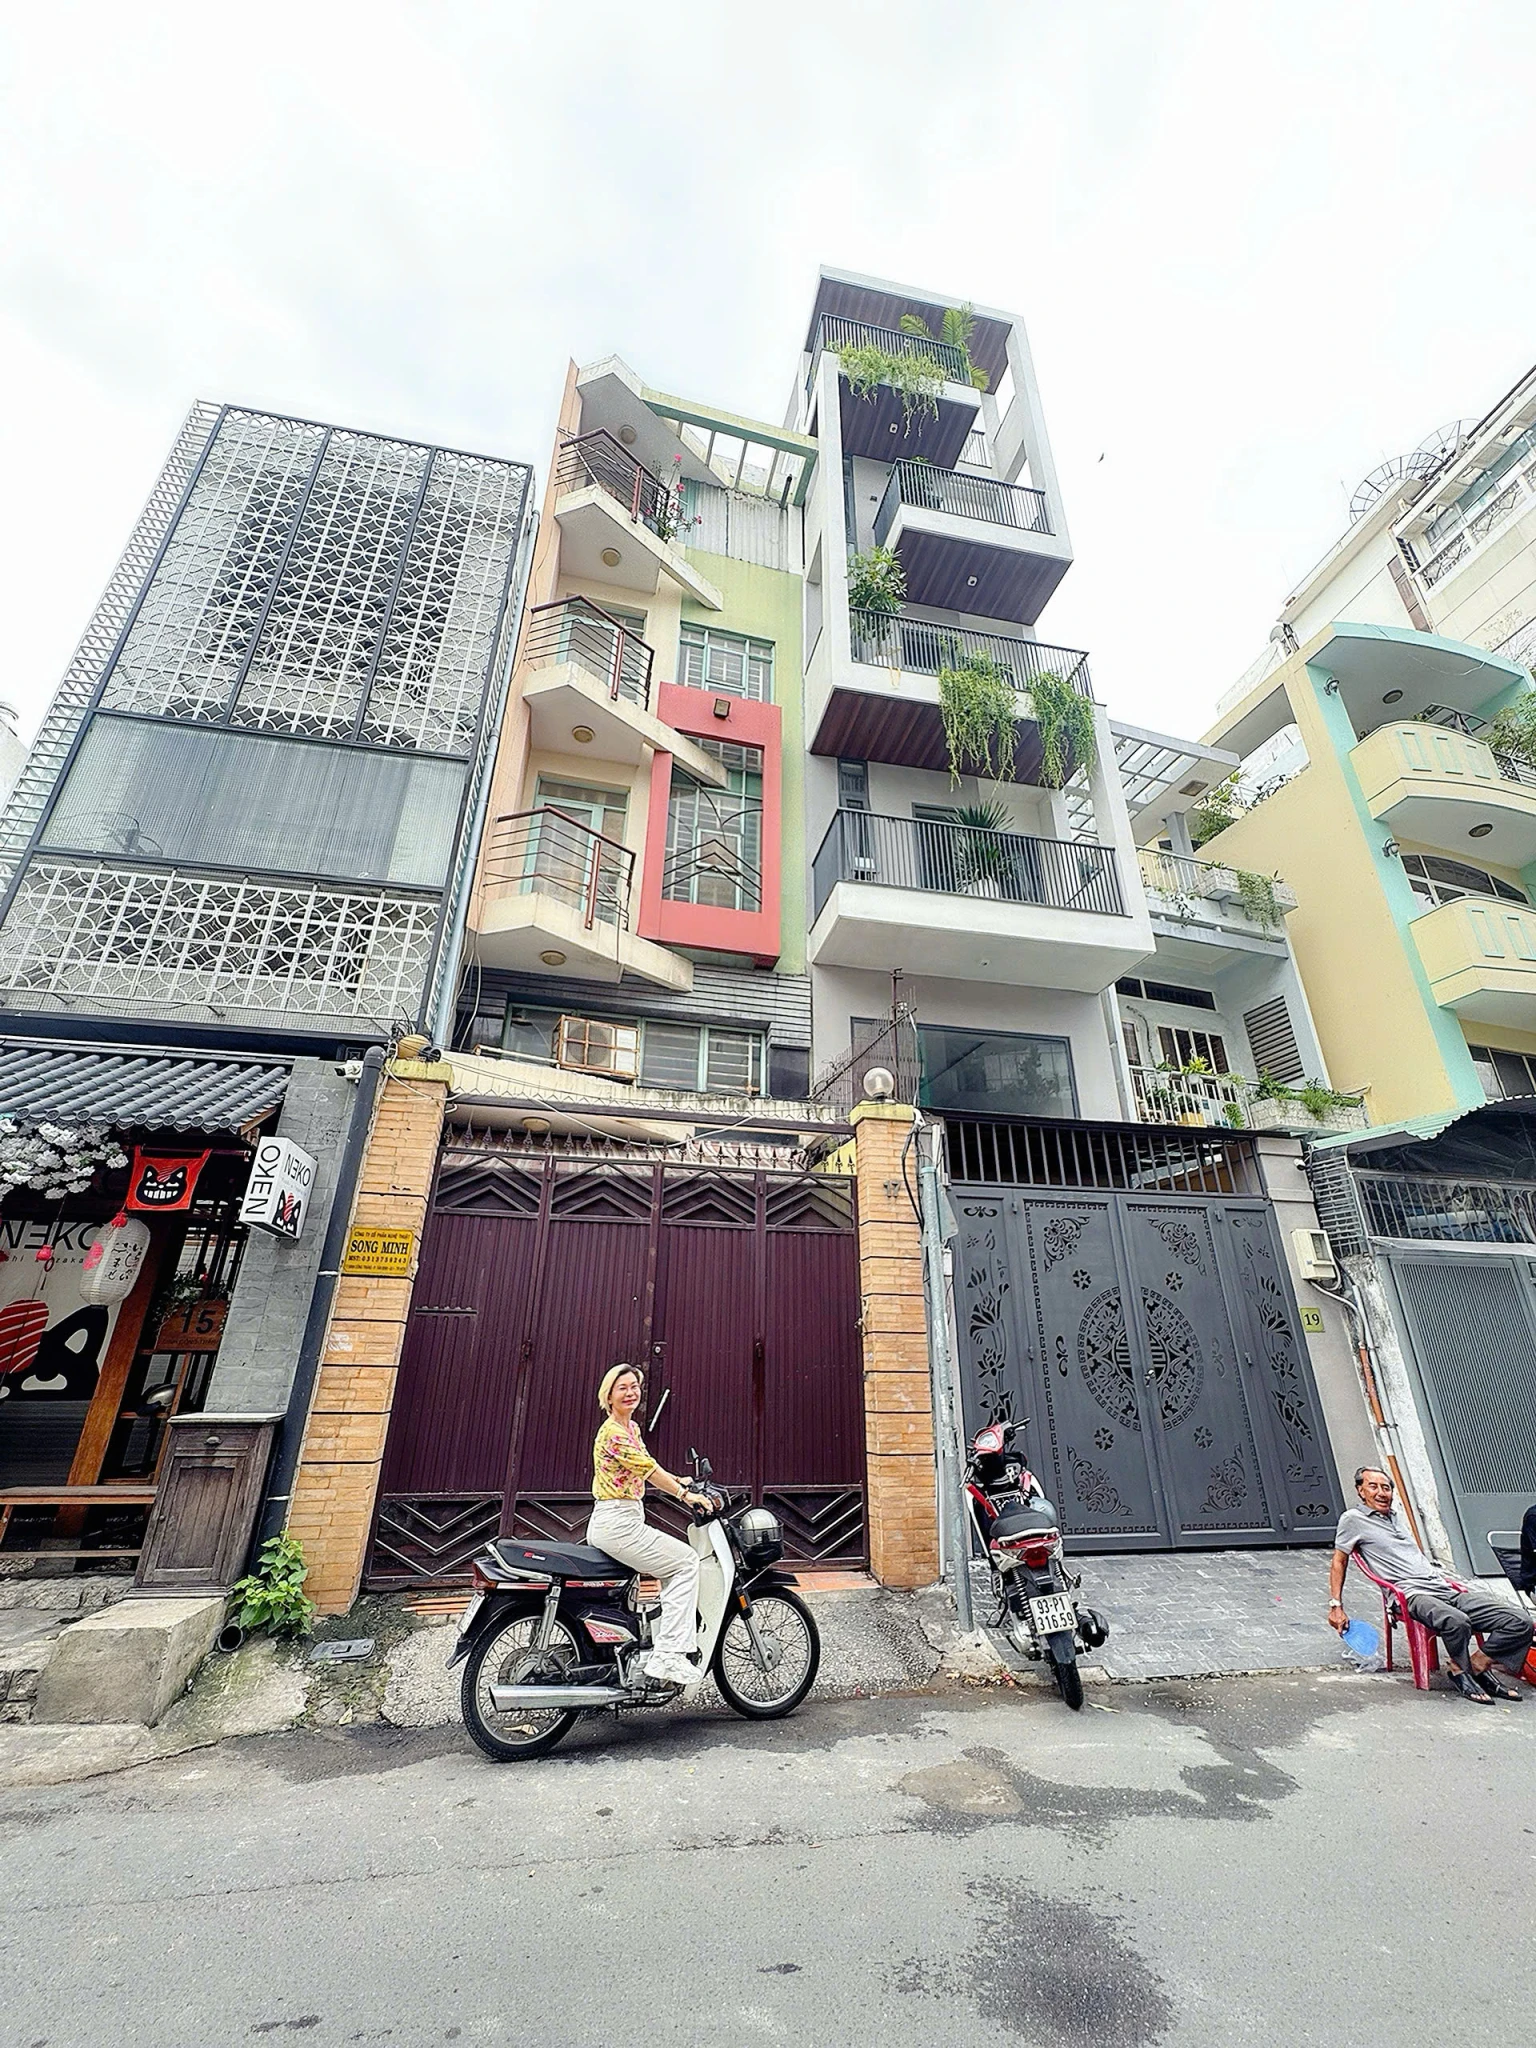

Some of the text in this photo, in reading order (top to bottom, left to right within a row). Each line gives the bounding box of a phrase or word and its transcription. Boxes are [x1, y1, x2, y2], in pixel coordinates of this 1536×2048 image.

[883, 1180, 900, 1198] 17
[350, 1240, 410, 1255] SONG MINH
[180, 1303, 216, 1334] 15
[1304, 1313, 1320, 1326] 19
[1036, 1596, 1066, 1614] 93-P1
[1037, 1611, 1075, 1631] 316.59
